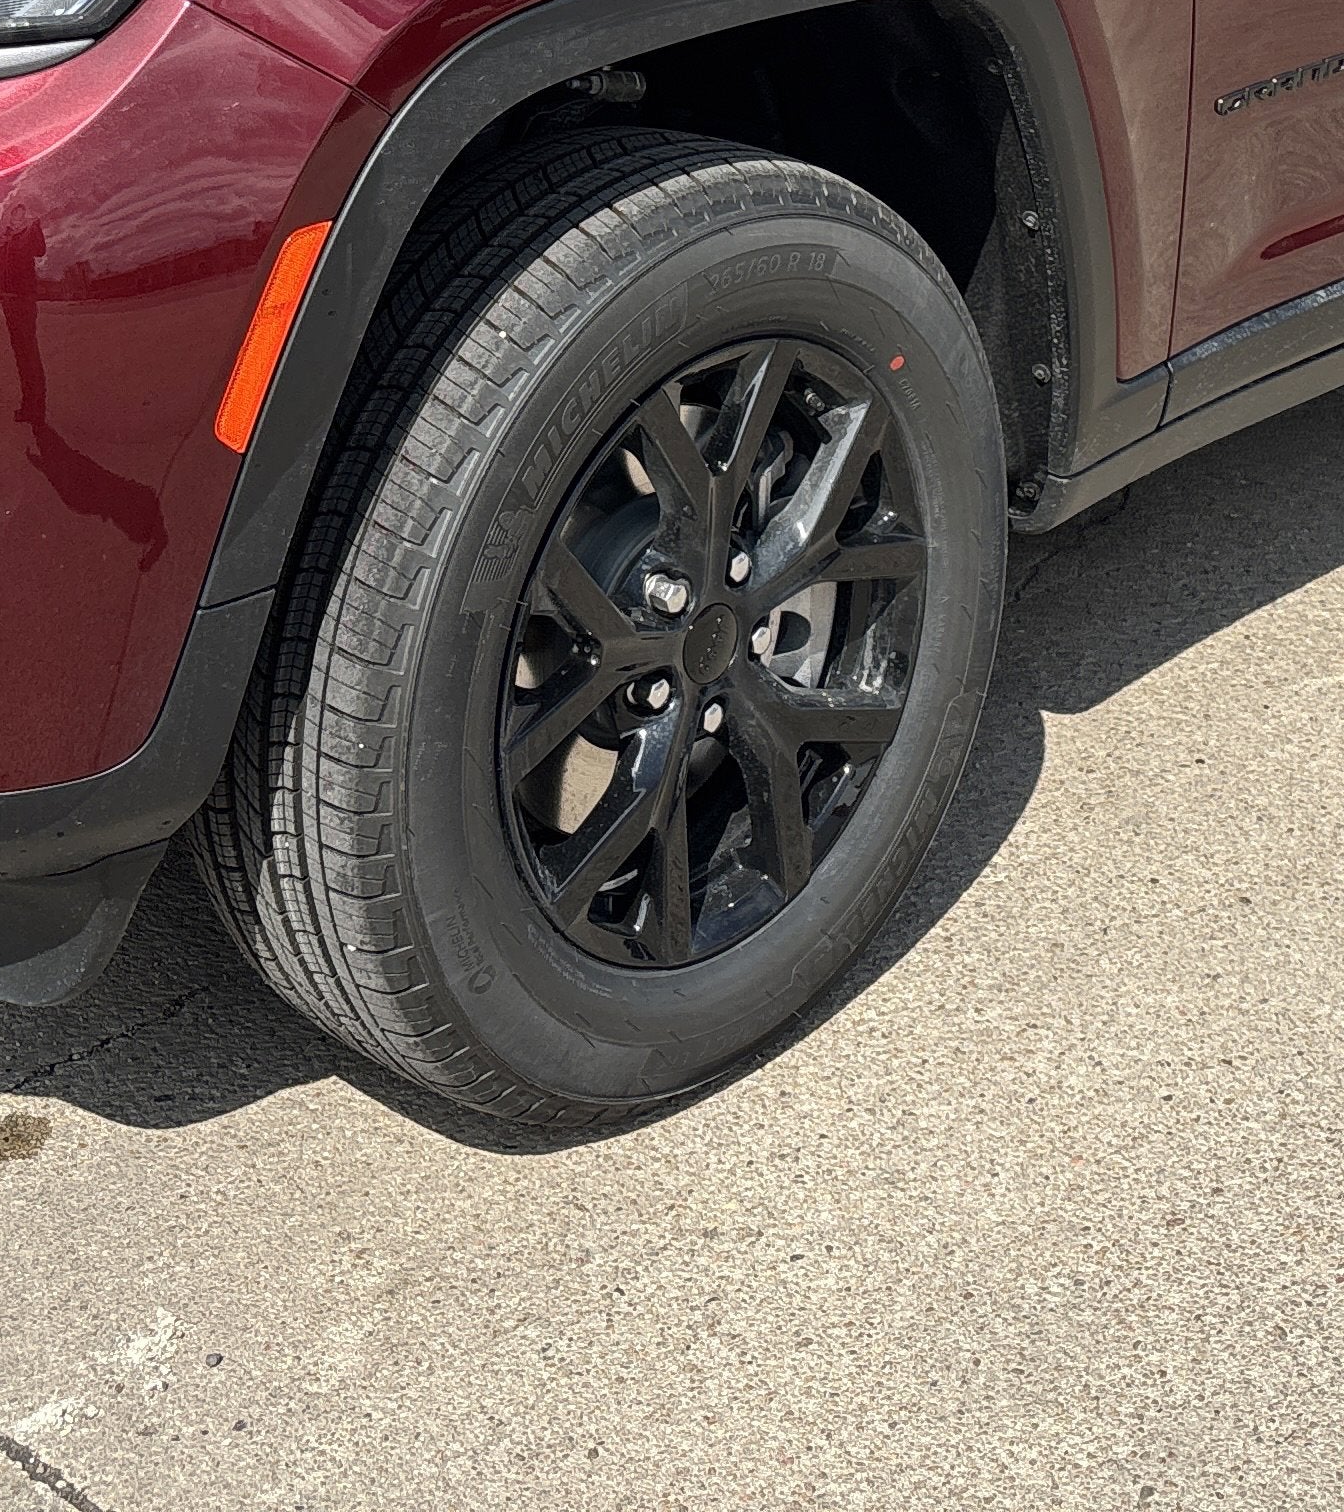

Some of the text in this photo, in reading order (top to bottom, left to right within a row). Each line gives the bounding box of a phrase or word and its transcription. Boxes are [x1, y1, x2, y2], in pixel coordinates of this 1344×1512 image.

[786, 251, 801, 272] R
[807, 251, 826, 272] 18
[521, 295, 682, 506] MICHELIN
